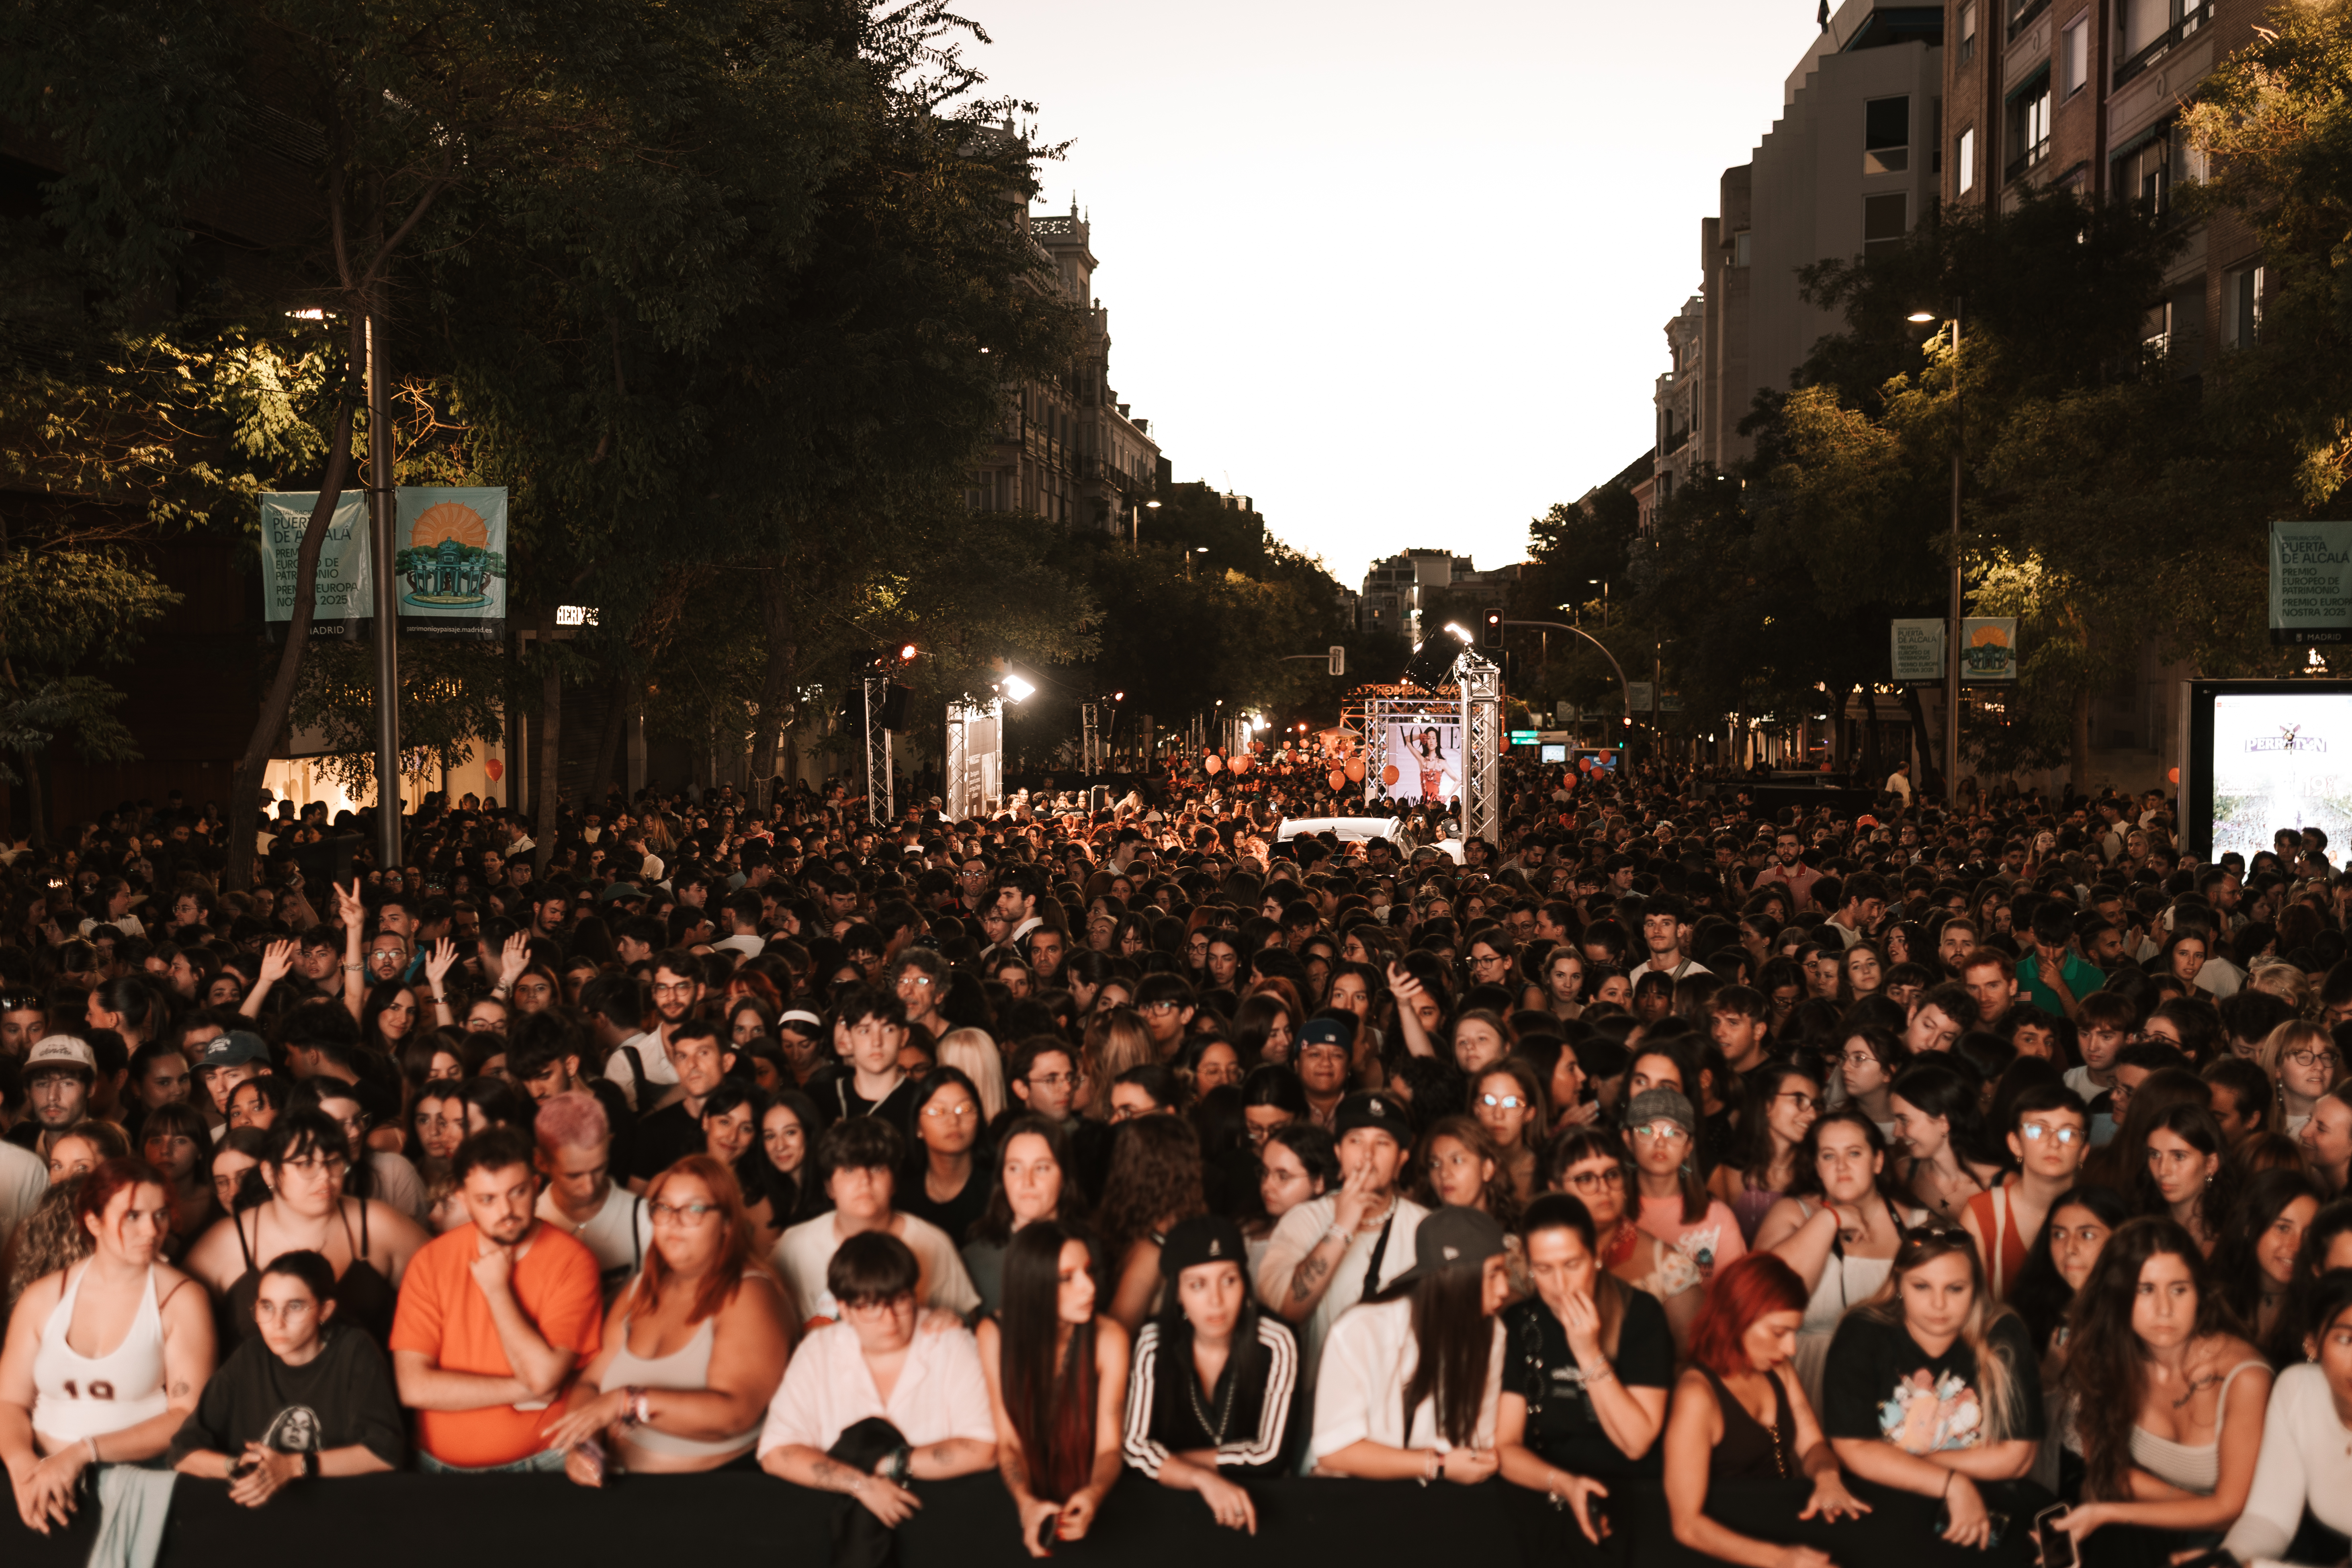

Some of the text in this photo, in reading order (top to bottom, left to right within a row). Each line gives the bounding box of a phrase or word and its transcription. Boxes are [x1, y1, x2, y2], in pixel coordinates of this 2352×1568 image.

[273, 517, 310, 530] PUER
[274, 527, 352, 543] DE AALÁ
[2282, 542, 2327, 552] PUERTA
[276, 548, 299, 558] PREM
[2282, 550, 2350, 563] DE ALCALÁ
[276, 558, 339, 569] EURO DE
[276, 569, 339, 580] PATRNIO
[2282, 568, 2317, 576] PREMIO
[2282, 577, 2325, 585] EUROPEO
[276, 583, 359, 595] PRE EUROPA
[2282, 586, 2340, 594] PATRIMONIO
[320, 595, 348, 605] 2025
[2282, 598, 2317, 606] PREMIO
[556, 605, 599, 626] HERM
[2282, 608, 2346, 616] NOSTRA 2025
[310, 626, 344, 635] ADRID
[407, 626, 493, 634] patrimonioypaisaje.madrid.es
[1400, 726, 1460, 749] VOUE
[2246, 737, 2325, 752] PERROTN
[2303, 775, 2327, 797] 19
